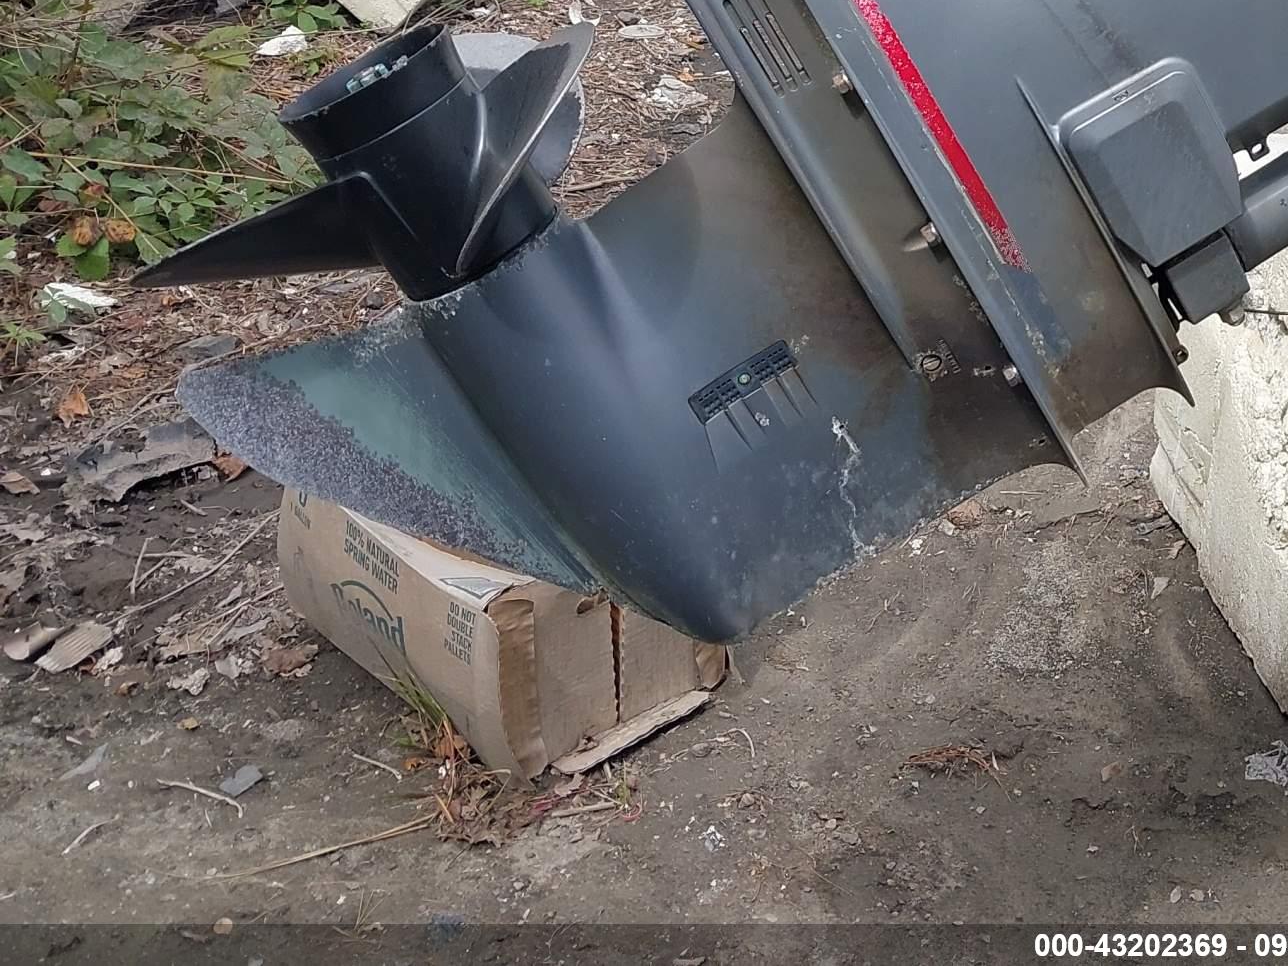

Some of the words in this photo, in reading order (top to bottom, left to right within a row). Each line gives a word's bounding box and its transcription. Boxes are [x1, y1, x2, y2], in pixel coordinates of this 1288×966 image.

[345, 519, 366, 549] 100%
[366, 536, 400, 578] NATURAL
[343, 537, 370, 572] SPRING
[370, 559, 399, 595] WATER
[447, 612, 475, 639] DOUBLE
[449, 600, 460, 616] DO
[461, 606, 477, 625] NOT
[444, 637, 472, 666] PALLETS
[451, 630, 472, 653] STACK
